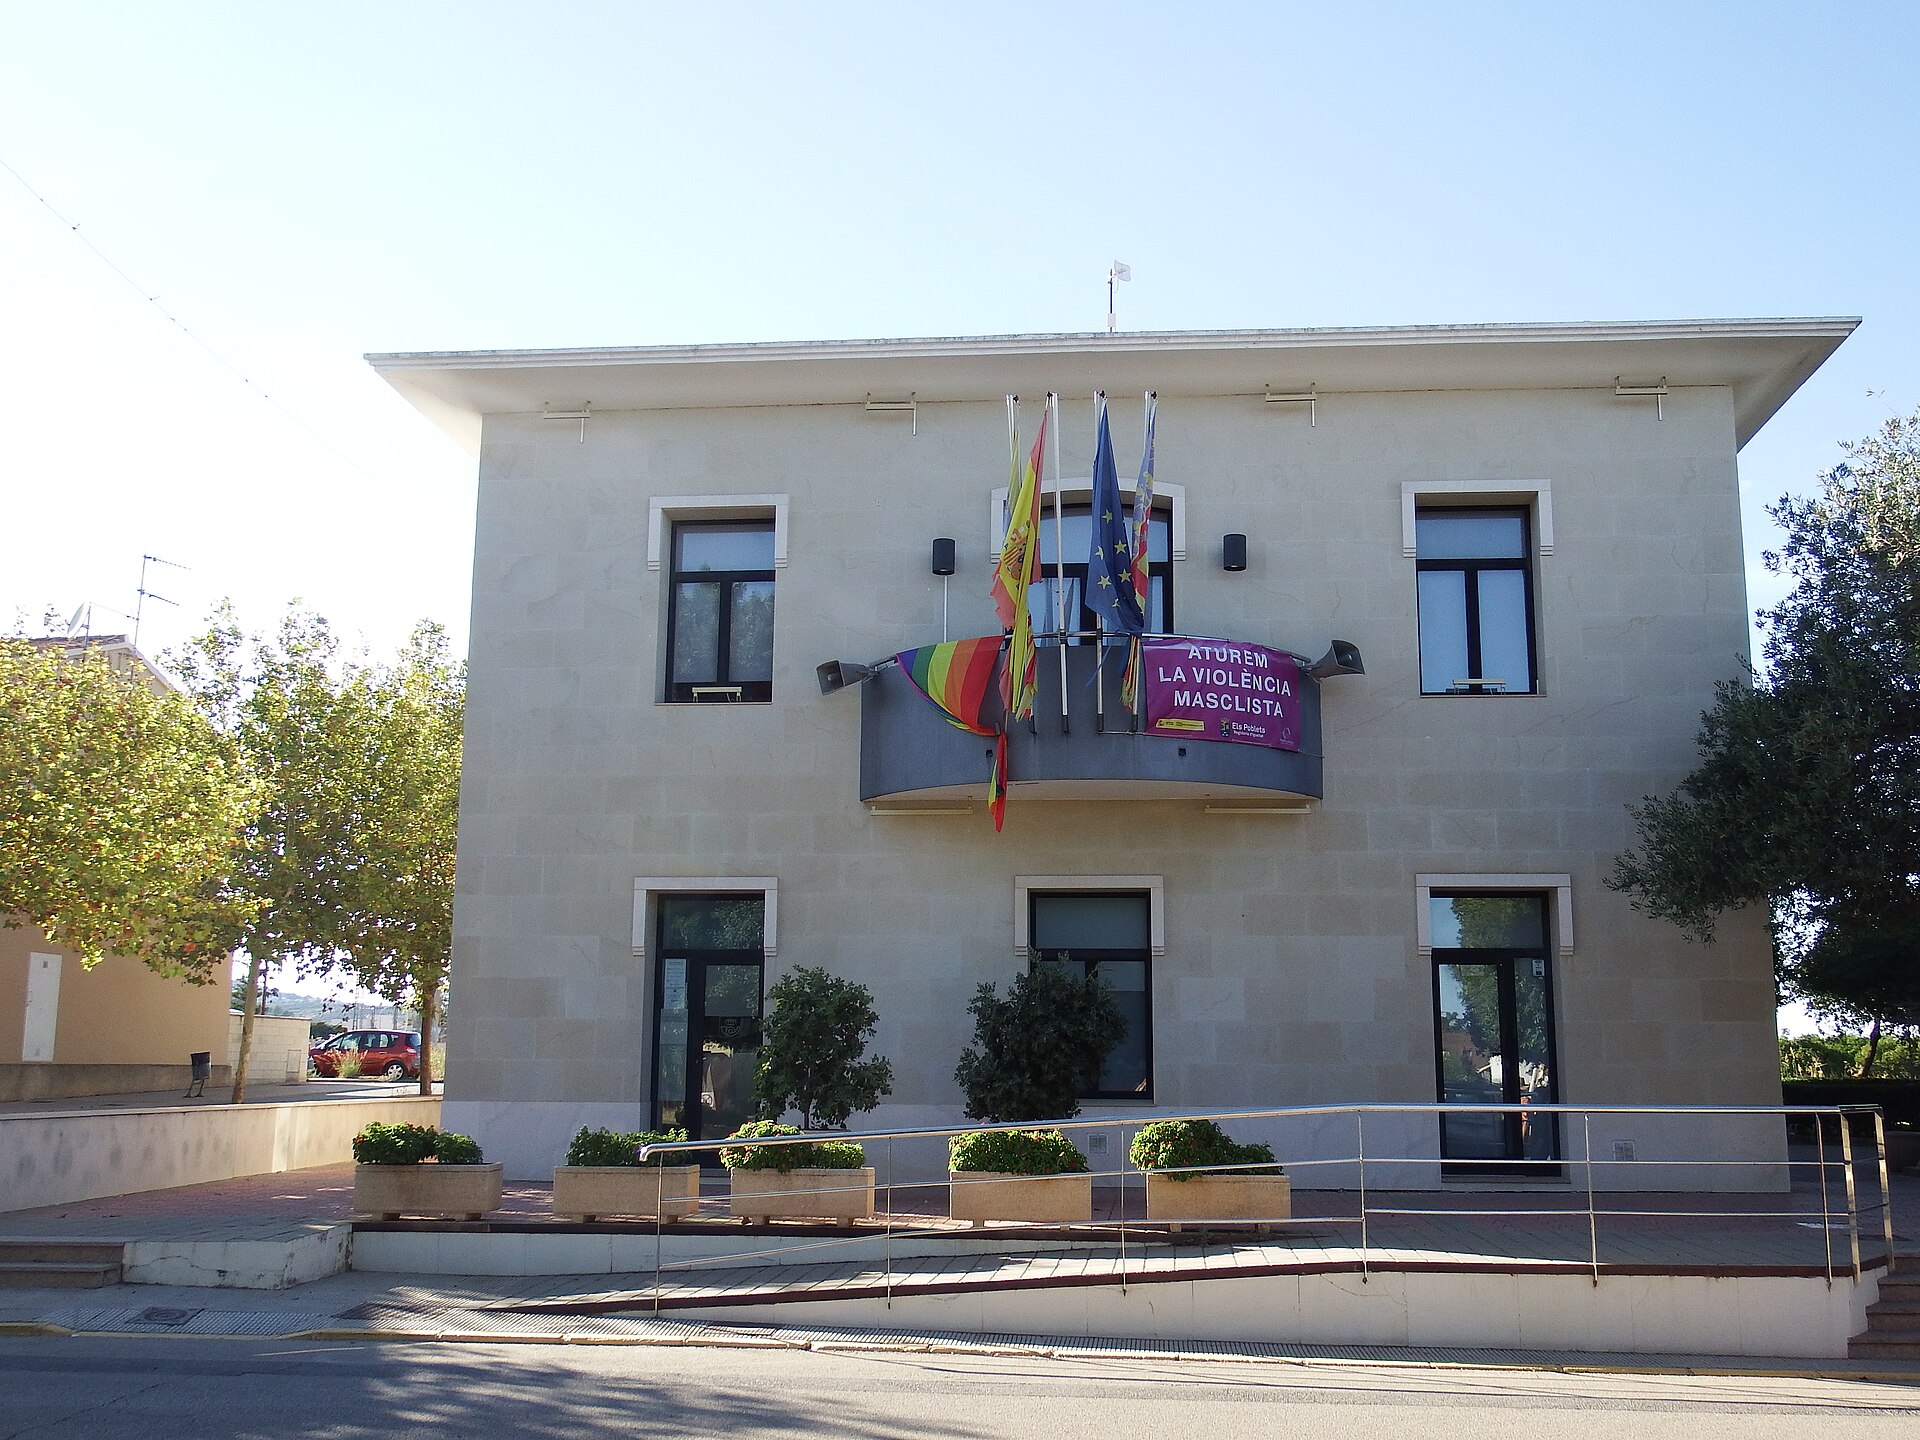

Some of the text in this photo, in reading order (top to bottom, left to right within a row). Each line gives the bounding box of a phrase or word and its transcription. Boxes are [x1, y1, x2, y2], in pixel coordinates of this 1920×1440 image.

[1188, 645, 1268, 669] ATUREM
[1159, 666, 1291, 697] LA VIOLÈNCIA
[1174, 690, 1283, 718] MASCLISTA
[1232, 722, 1266, 734] Els Poblets
